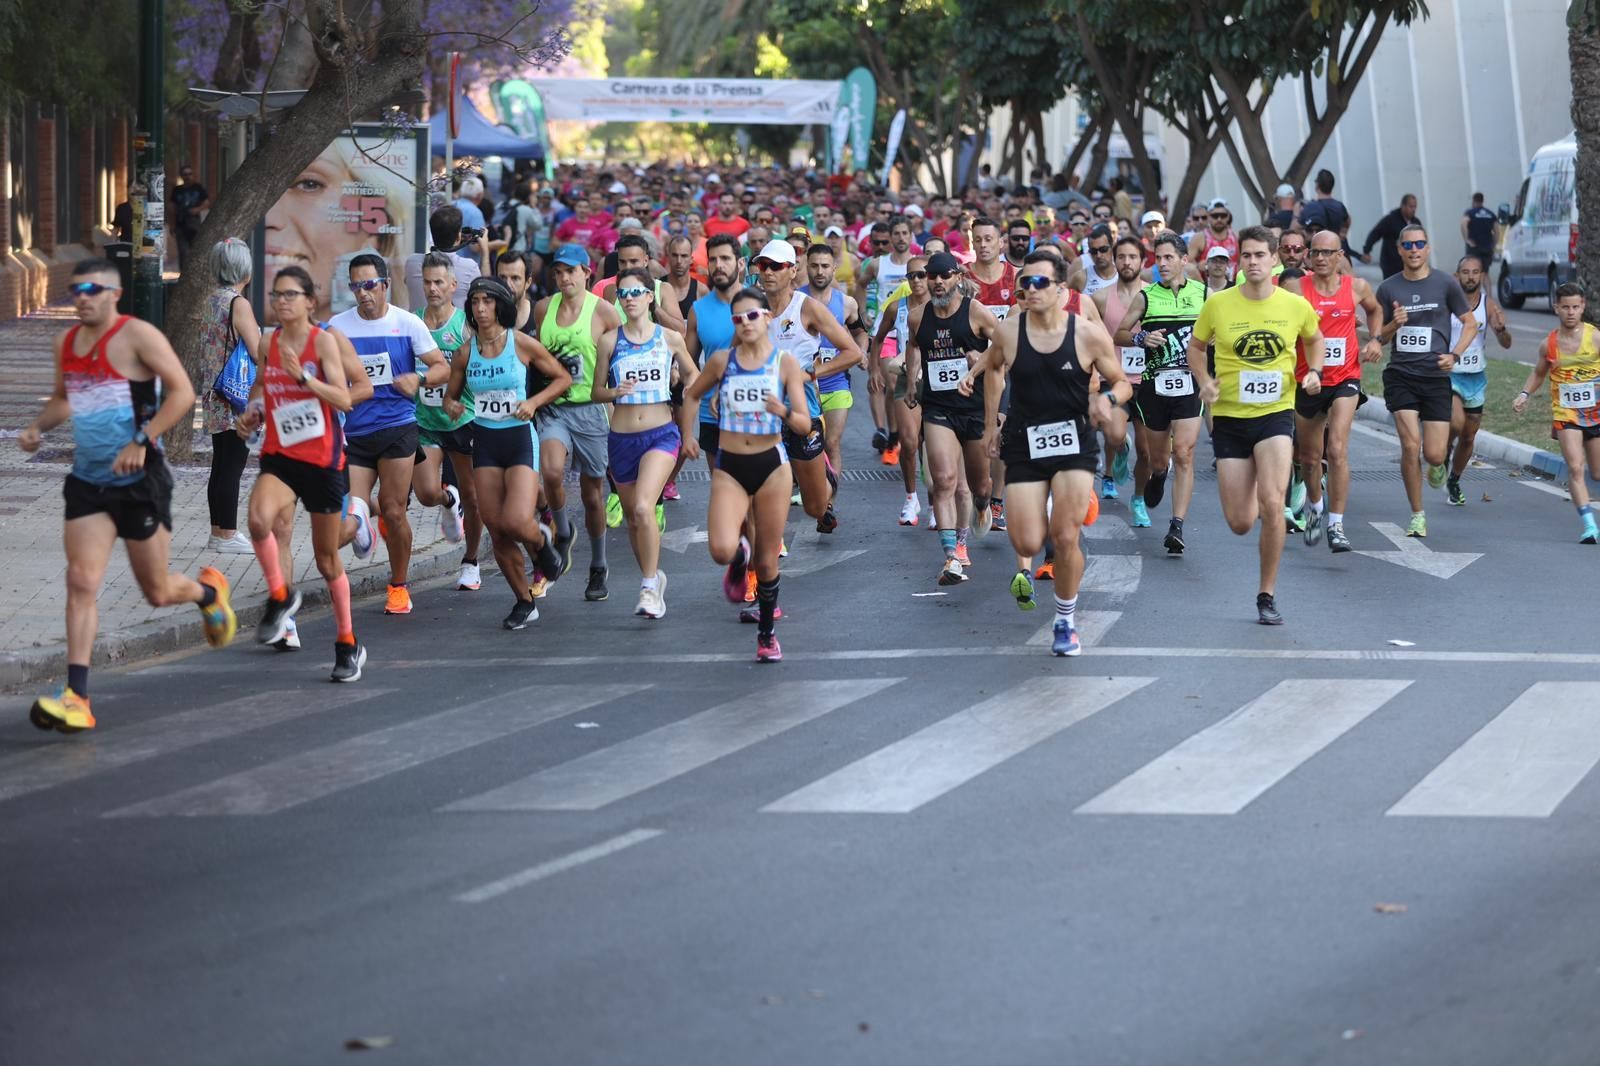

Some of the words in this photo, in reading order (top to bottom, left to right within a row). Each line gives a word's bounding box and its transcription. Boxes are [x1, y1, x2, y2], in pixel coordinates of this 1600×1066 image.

[611, 81, 669, 96] Carrera
[671, 82, 691, 96] de
[712, 83, 763, 97] Prensa
[341, 196, 388, 233] 15
[937, 329, 951, 338] WE
[1400, 335, 1427, 346] 696
[626, 369, 661, 382] 658
[938, 370, 959, 382] 83
[1165, 379, 1183, 390] 59
[1244, 382, 1277, 394] 432
[734, 389, 771, 402] 665
[1563, 391, 1591, 402] 189
[480, 401, 510, 414] 701
[281, 411, 318, 435] 635
[1035, 433, 1073, 450] 336
